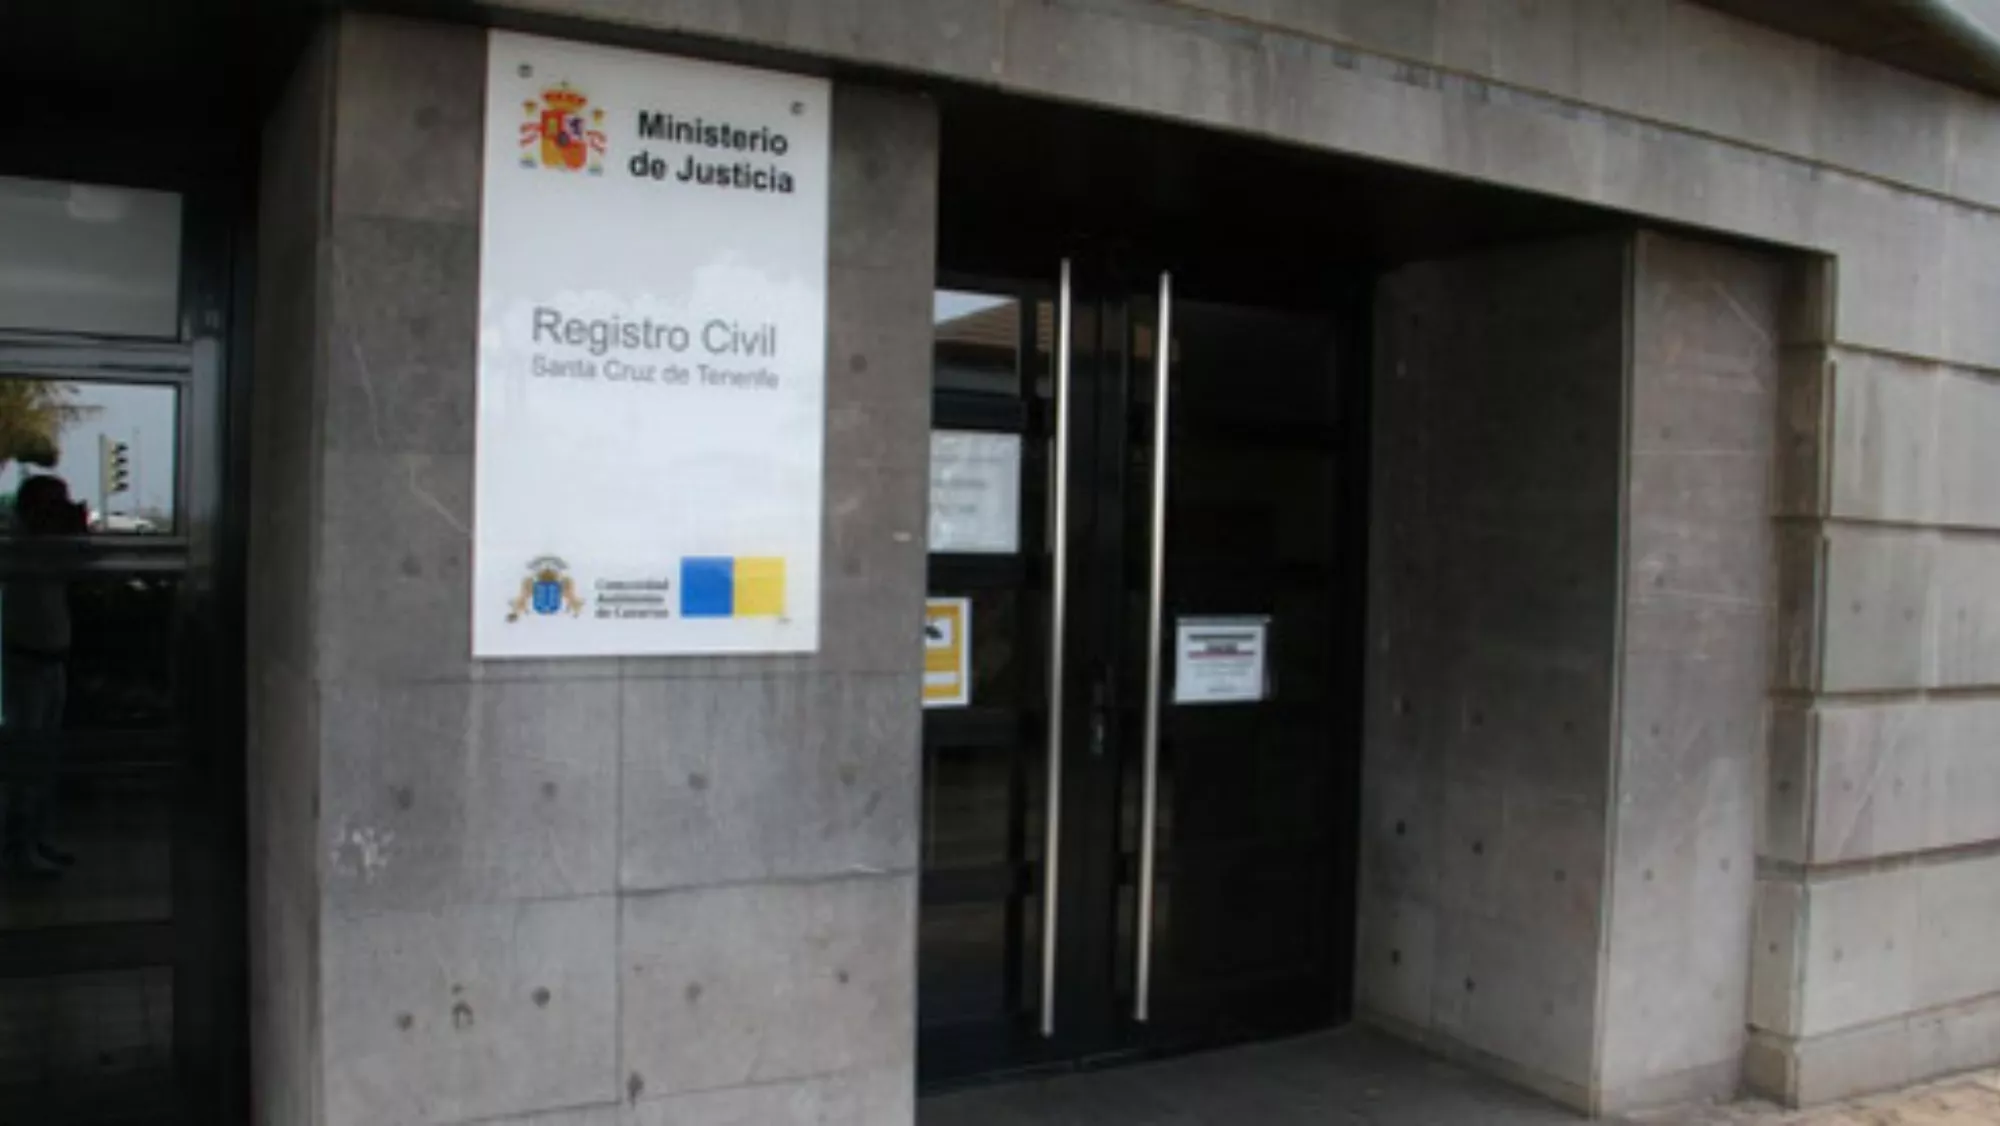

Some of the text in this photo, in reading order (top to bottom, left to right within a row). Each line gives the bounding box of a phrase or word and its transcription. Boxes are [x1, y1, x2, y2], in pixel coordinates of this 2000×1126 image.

[638, 110, 788, 155] Ministerio
[629, 151, 794, 194] de Justicia
[532, 305, 777, 357] Registro Civil
[532, 354, 779, 389] Santa Cruz de Tenerife
